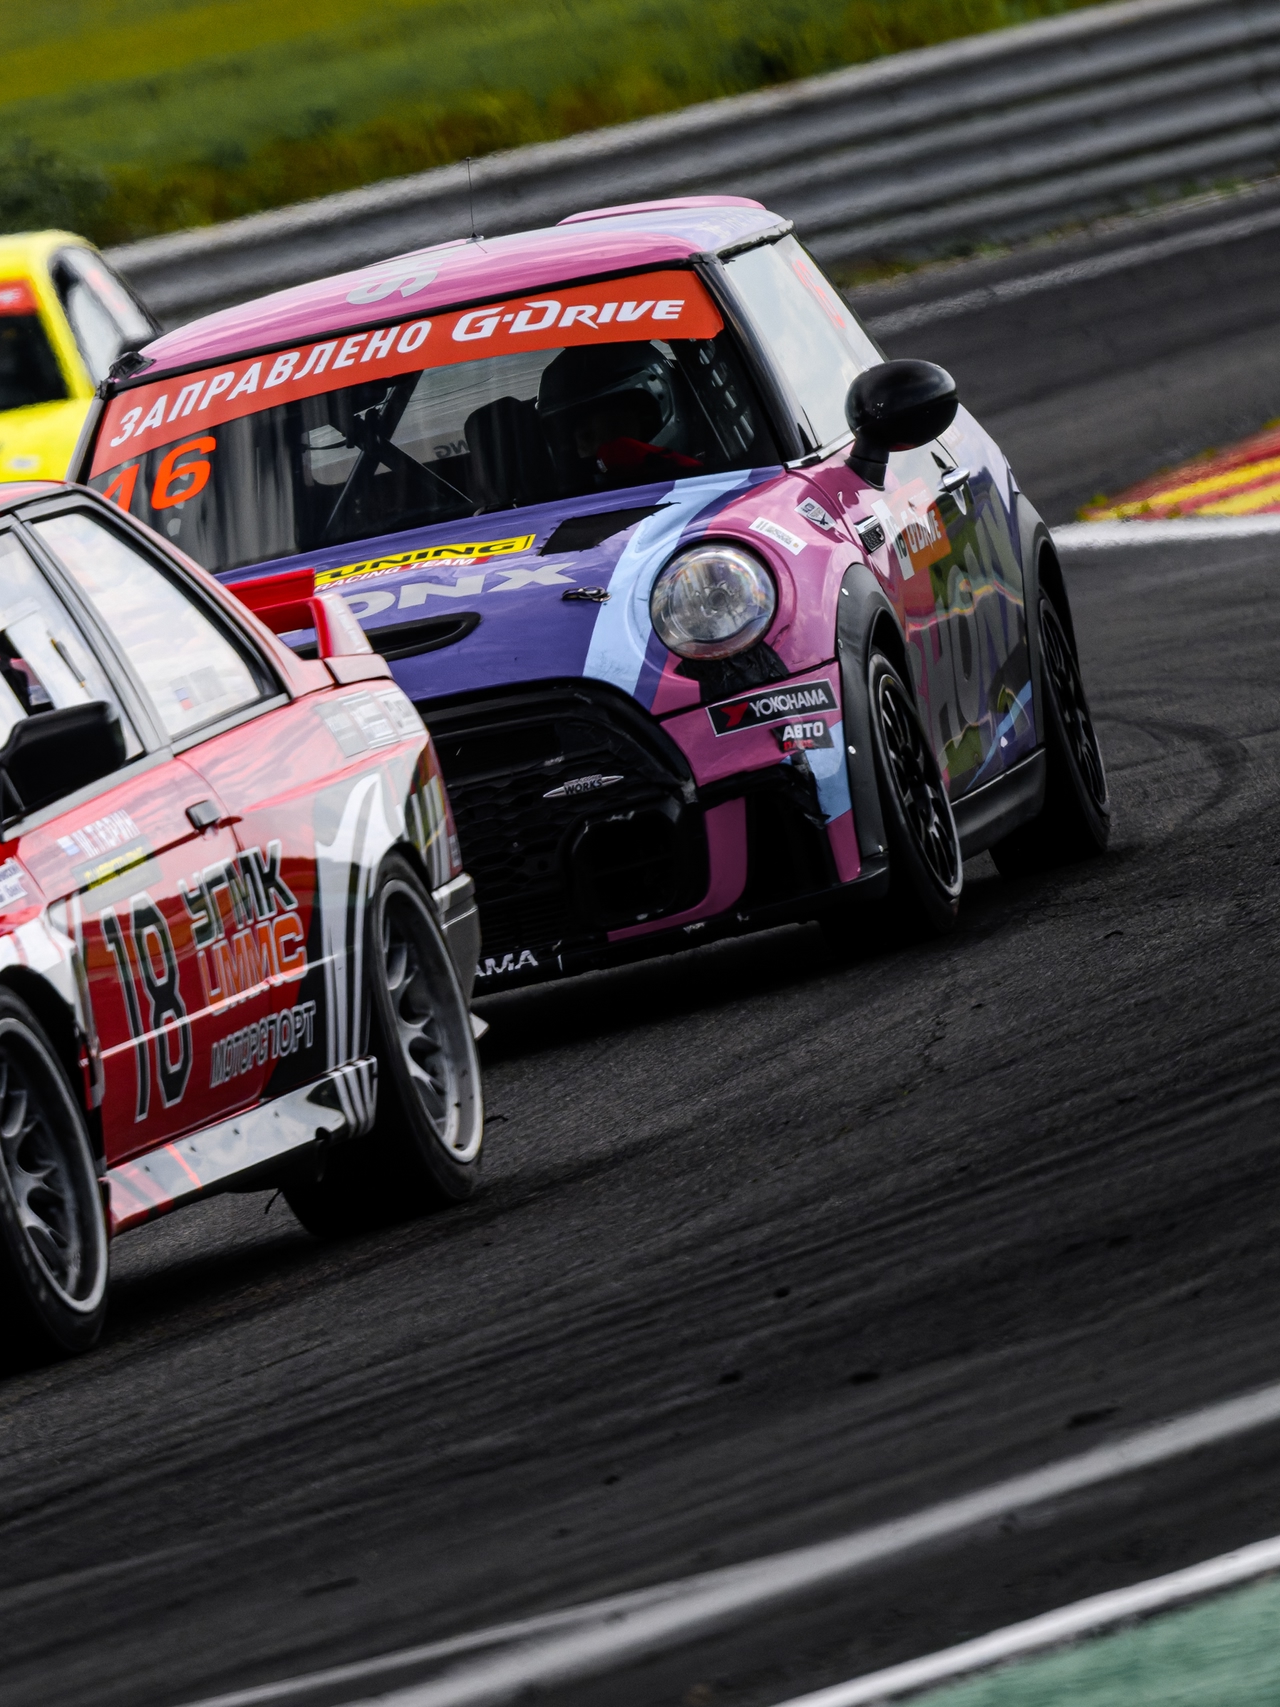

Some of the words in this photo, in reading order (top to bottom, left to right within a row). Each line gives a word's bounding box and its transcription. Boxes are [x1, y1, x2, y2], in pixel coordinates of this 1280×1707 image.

[111, 320, 430, 447] ЗАПРАВЛЕНО
[102, 436, 217, 514] 16
[410, 556, 475, 571] TEAM
[750, 688, 829, 717] YOKOHAMA
[782, 721, 824, 741] АВТО
[564, 780, 603, 795] WORKS
[177, 839, 298, 950] УГМК
[197, 911, 308, 1016] UMMC
[100, 889, 193, 1123] 18
